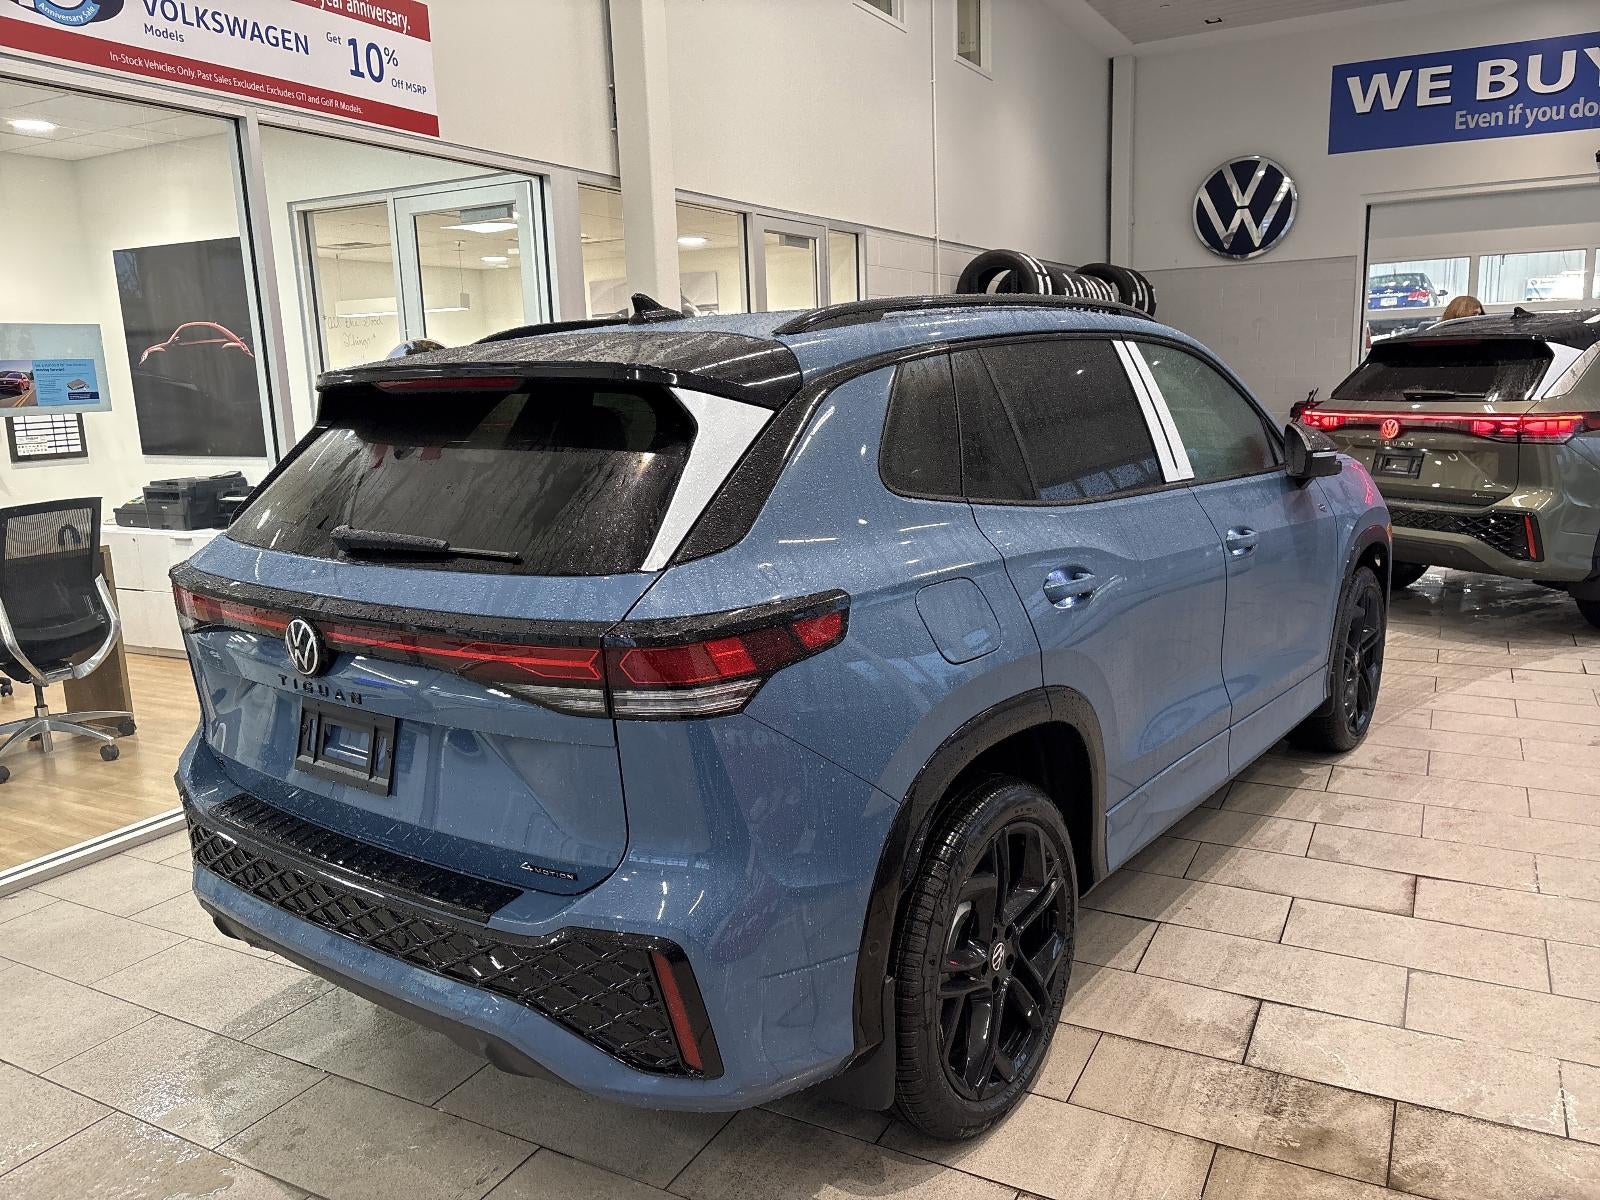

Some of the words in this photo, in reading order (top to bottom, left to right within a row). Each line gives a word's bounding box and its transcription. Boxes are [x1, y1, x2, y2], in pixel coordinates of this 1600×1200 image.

[39, 2, 84, 22] Anniversary
[82, 6, 95, 18] Sale
[143, 0, 310, 55] VOLKSWAGEN
[346, 0, 411, 33] anniversary.
[144, 23, 185, 43] Models
[326, 32, 342, 46] Get
[109, 51, 143, 67] In-Stock
[144, 59, 176, 74] Vehicles
[177, 65, 197, 79] Only.
[197, 69, 213, 82] Past
[213, 73, 232, 86] Sales
[233, 77, 266, 92] Excluded.
[266, 84, 295, 99] Excludes
[295, 91, 307, 102] GTI
[307, 94, 320, 106] and
[320, 97, 334, 108] Golf
[334, 99, 340, 109] R
[340, 101, 363, 114] Models.
[391, 78, 404, 90] Off
[405, 81, 427, 96] MSRP
[1347, 64, 1453, 114] WE
[1454, 110, 1504, 130] Even
[1508, 103, 1524, 125] if
[1525, 105, 1565, 128] you
[1569, 96, 1600, 118] do
[278, 673, 363, 705] TIGUAN
